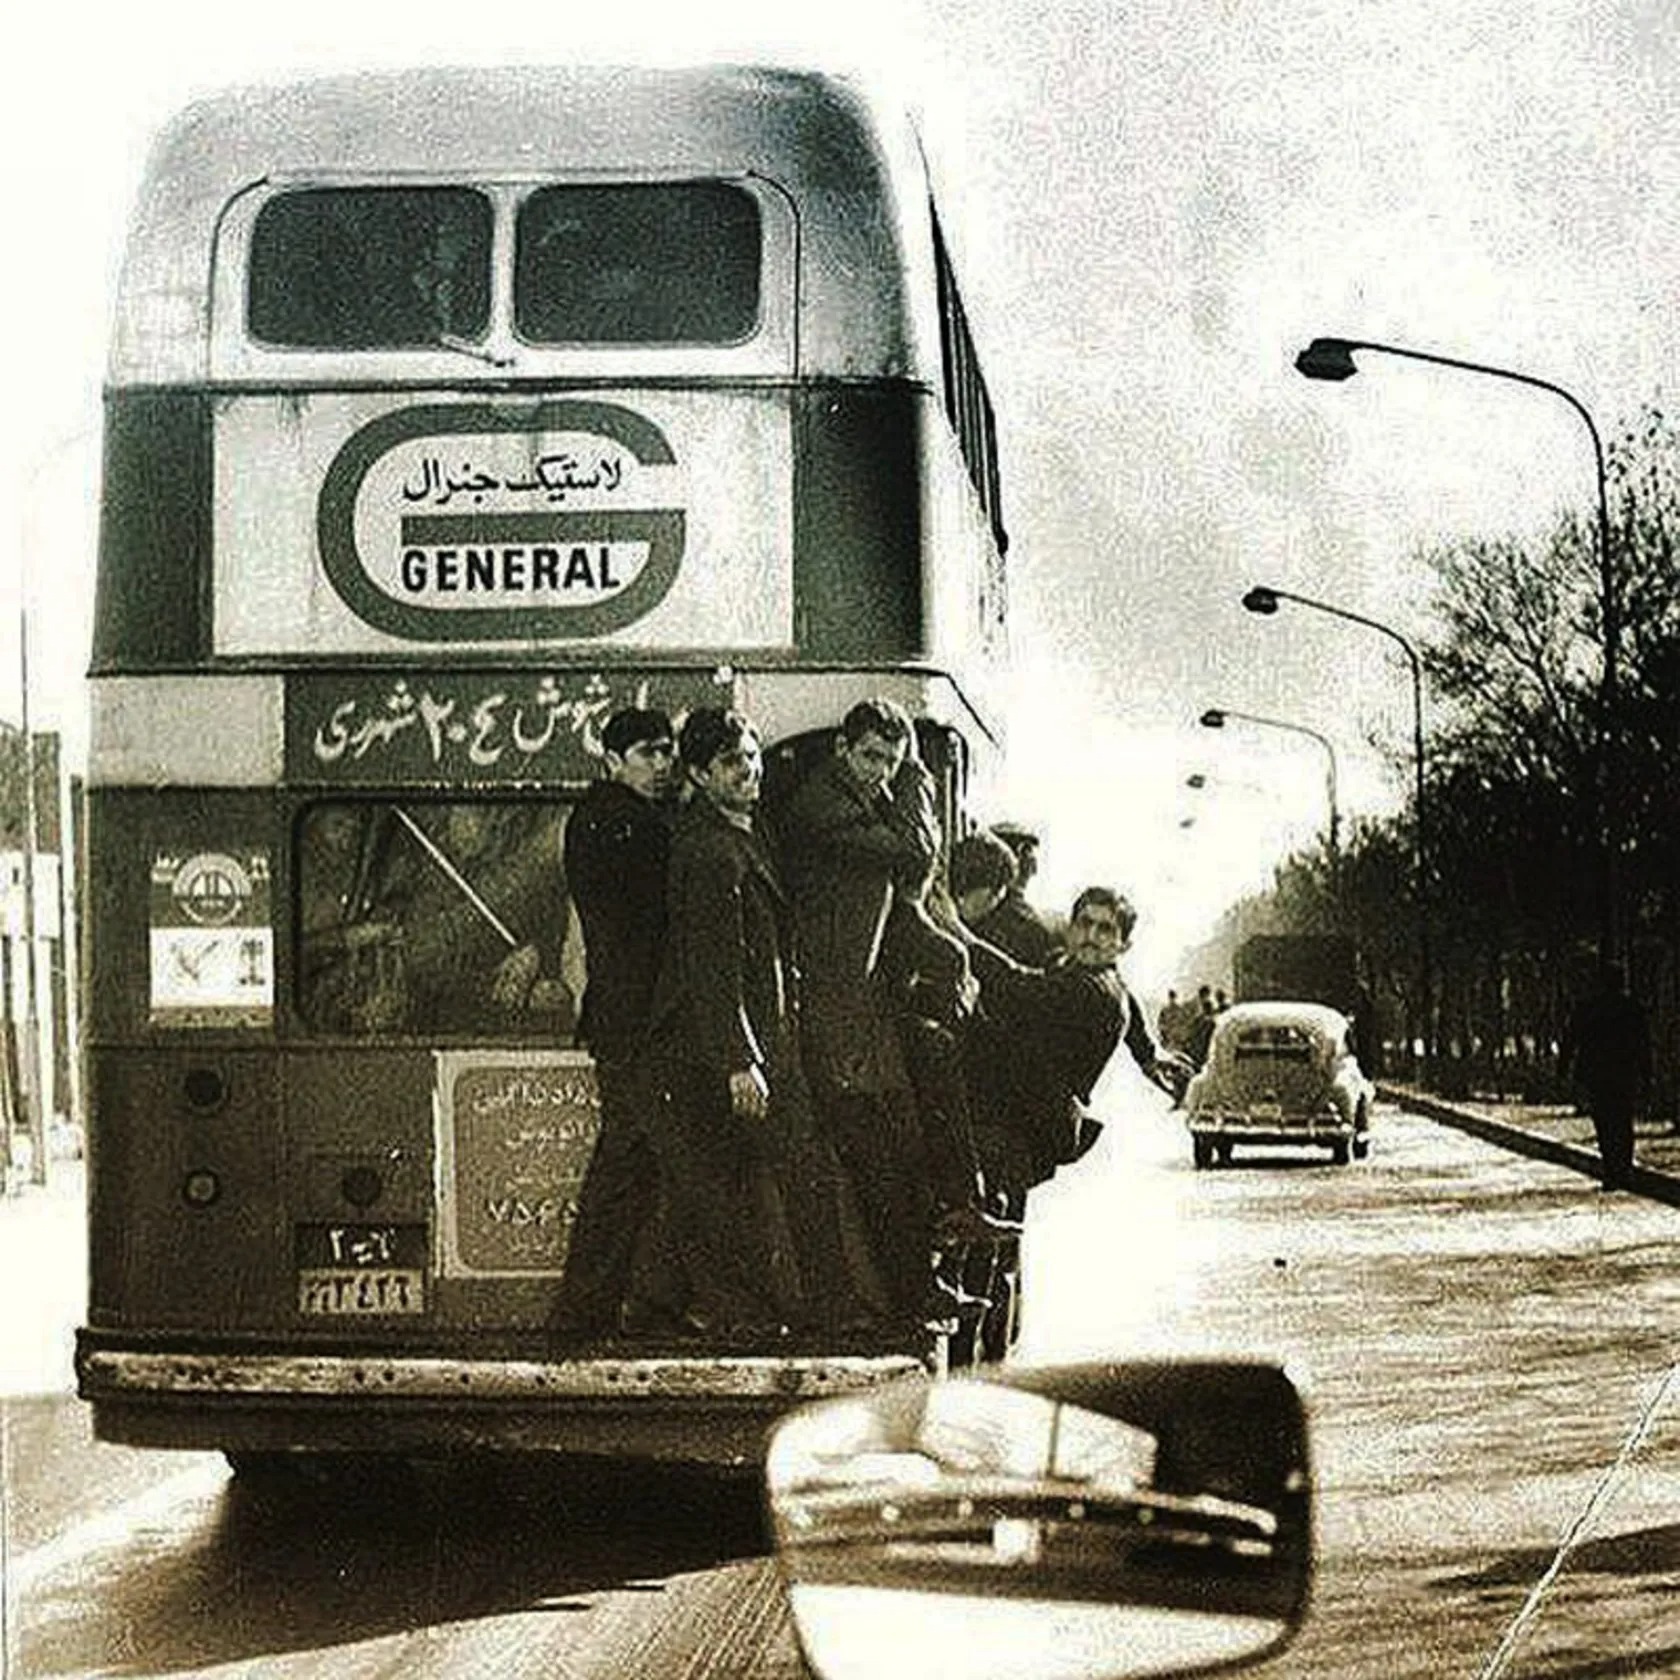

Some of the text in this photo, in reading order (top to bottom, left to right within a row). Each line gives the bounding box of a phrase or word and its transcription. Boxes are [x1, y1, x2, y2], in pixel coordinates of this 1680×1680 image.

[402, 455, 622, 505] لاستیک جنرال
[402, 546, 621, 593] GENERAL
